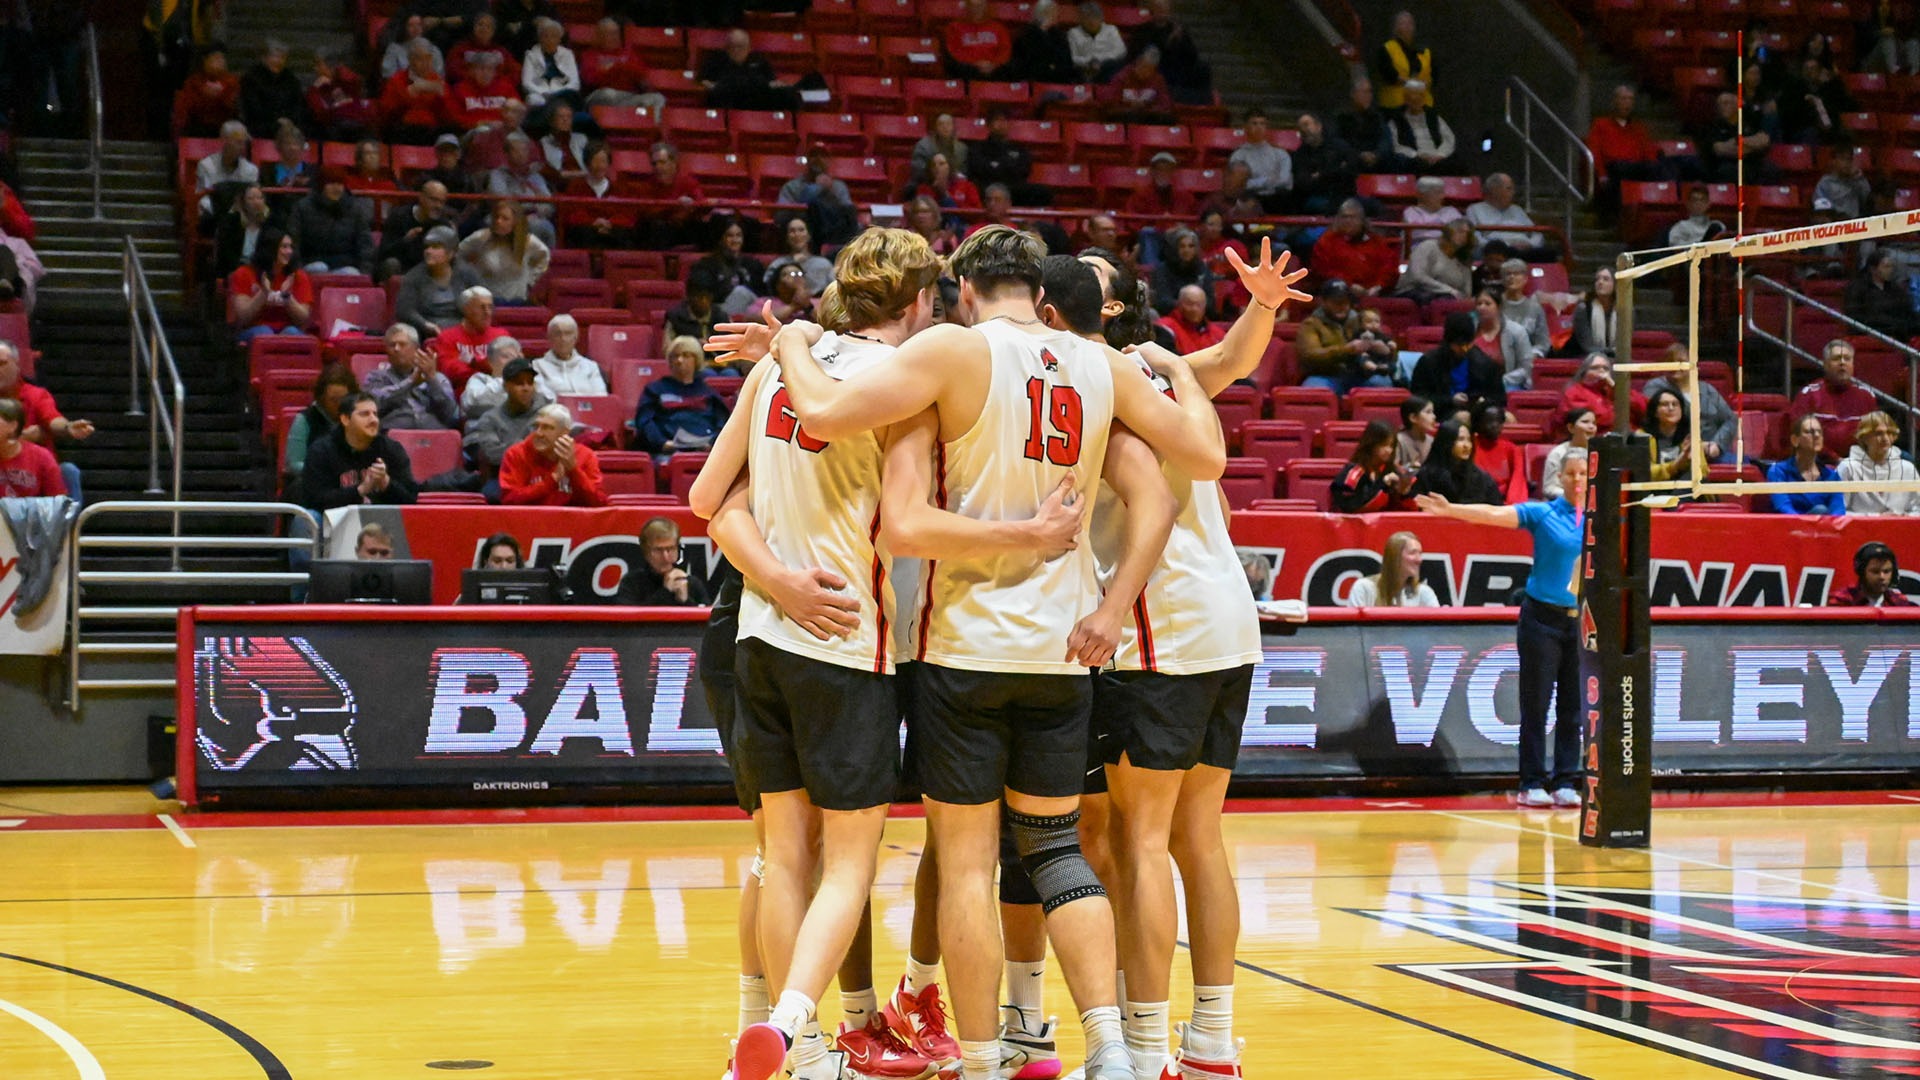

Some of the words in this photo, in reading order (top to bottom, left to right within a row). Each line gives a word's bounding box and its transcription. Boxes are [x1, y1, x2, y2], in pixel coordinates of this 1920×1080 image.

[1763, 234, 1784, 247] BALL
[1785, 229, 1811, 243] STATE
[1812, 221, 1868, 239] VOLLEYBALL
[1024, 376, 1083, 467] 19
[1584, 451, 1599, 579] BALL
[424, 647, 724, 757] BAL
[1620, 675, 1633, 720] sports
[1583, 675, 1600, 838] STATE
[1620, 721, 1633, 775] imports
[473, 781, 549, 791] DAKTRONICS
